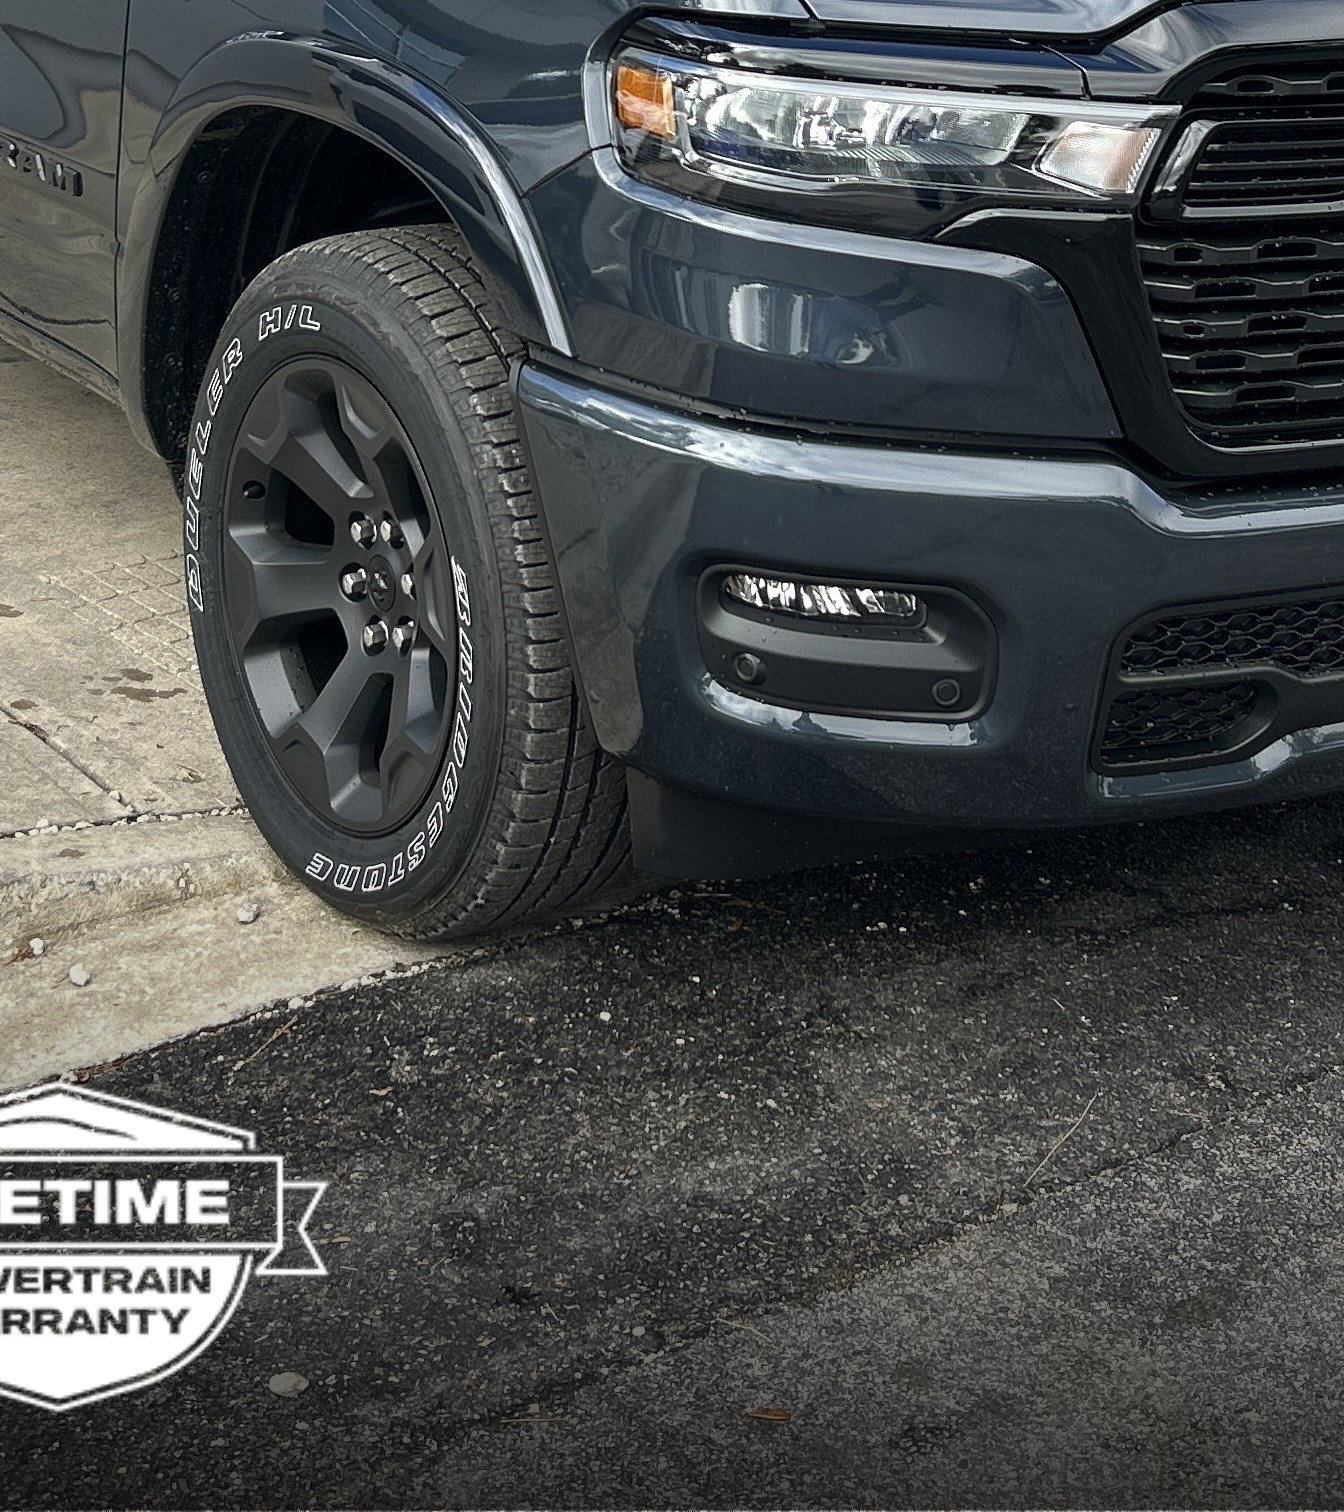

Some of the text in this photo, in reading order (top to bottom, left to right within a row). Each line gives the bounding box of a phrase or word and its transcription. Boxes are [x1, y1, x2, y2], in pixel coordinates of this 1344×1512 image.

[185, 304, 321, 613] DUELER H/L
[304, 554, 474, 892] BRIDGESTONE
